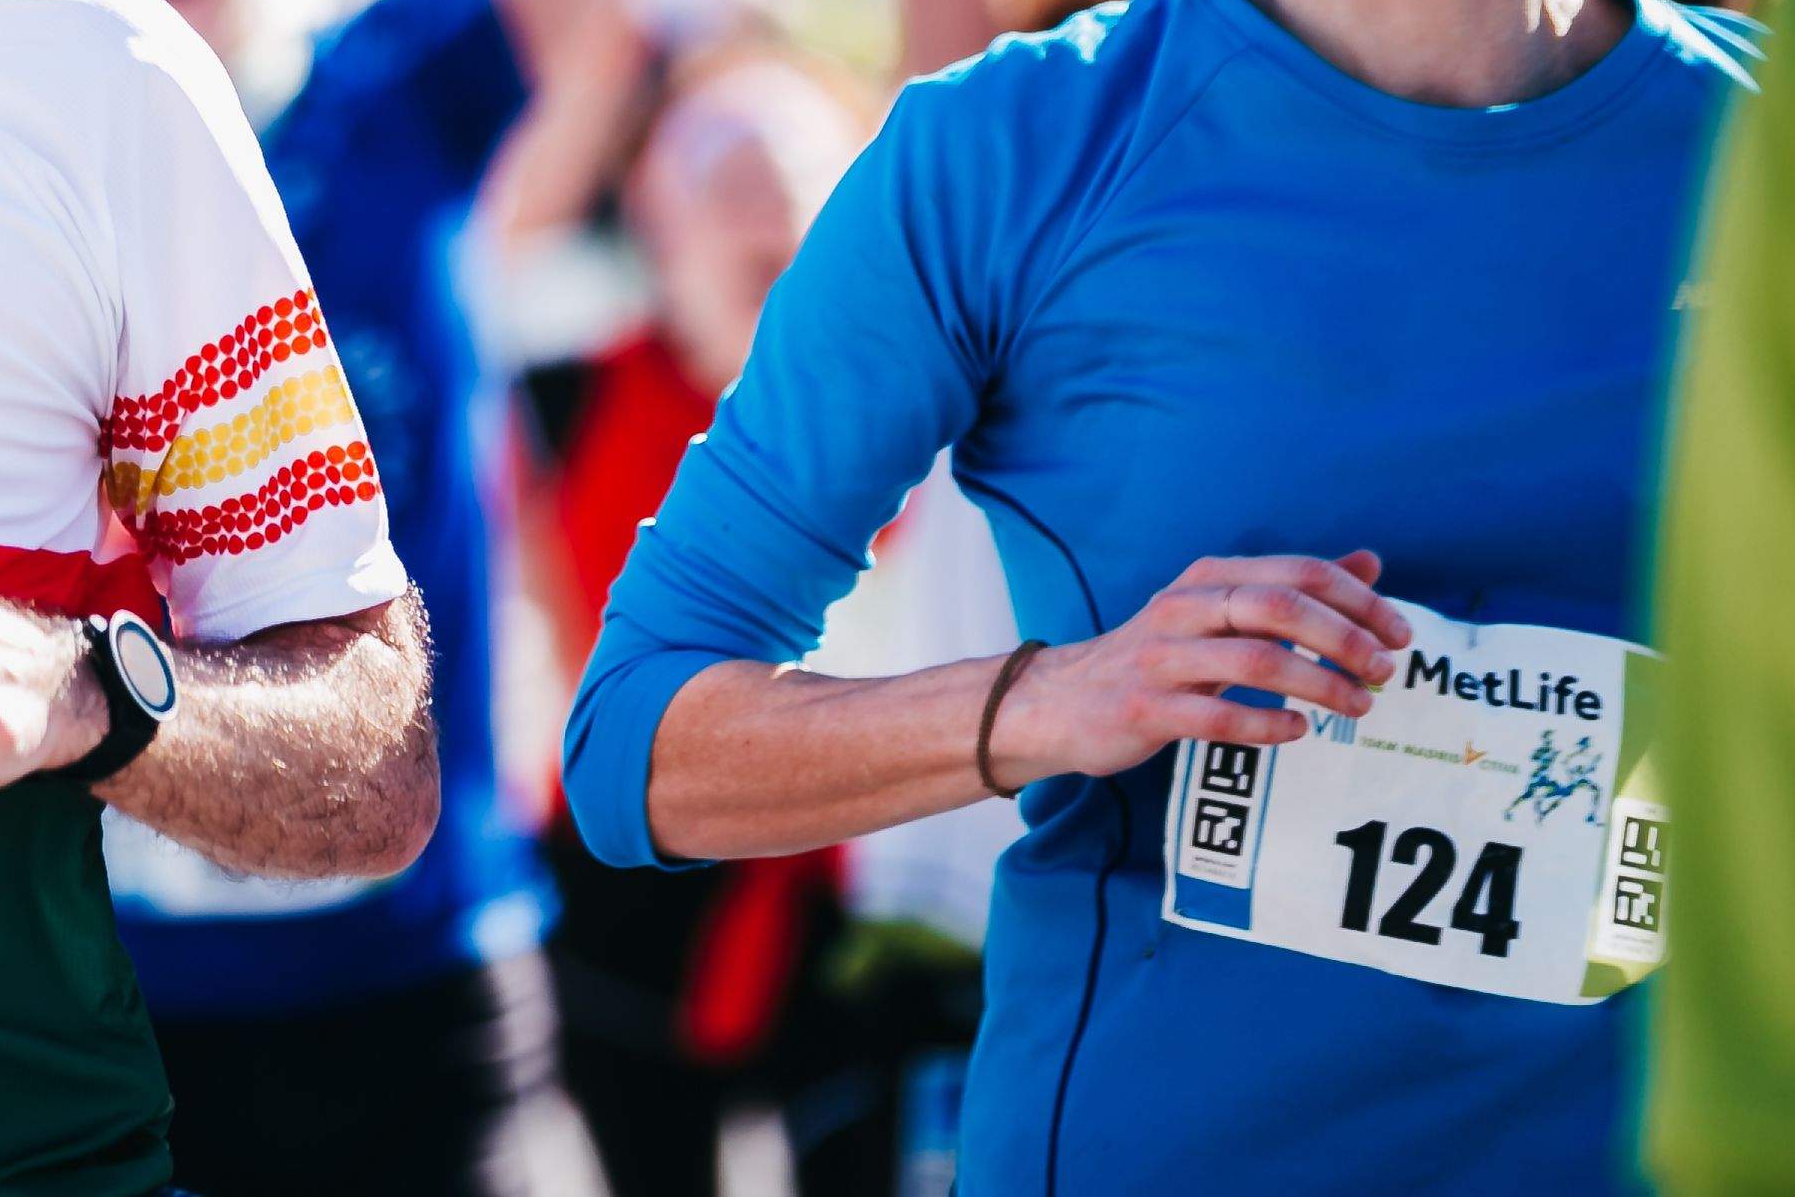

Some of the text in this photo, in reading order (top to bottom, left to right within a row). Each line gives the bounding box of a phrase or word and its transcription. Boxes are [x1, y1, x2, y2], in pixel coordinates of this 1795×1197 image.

[1405, 650, 1603, 721] MetLife
[1309, 709, 1358, 745] VIII
[1335, 820, 1523, 958] 124
